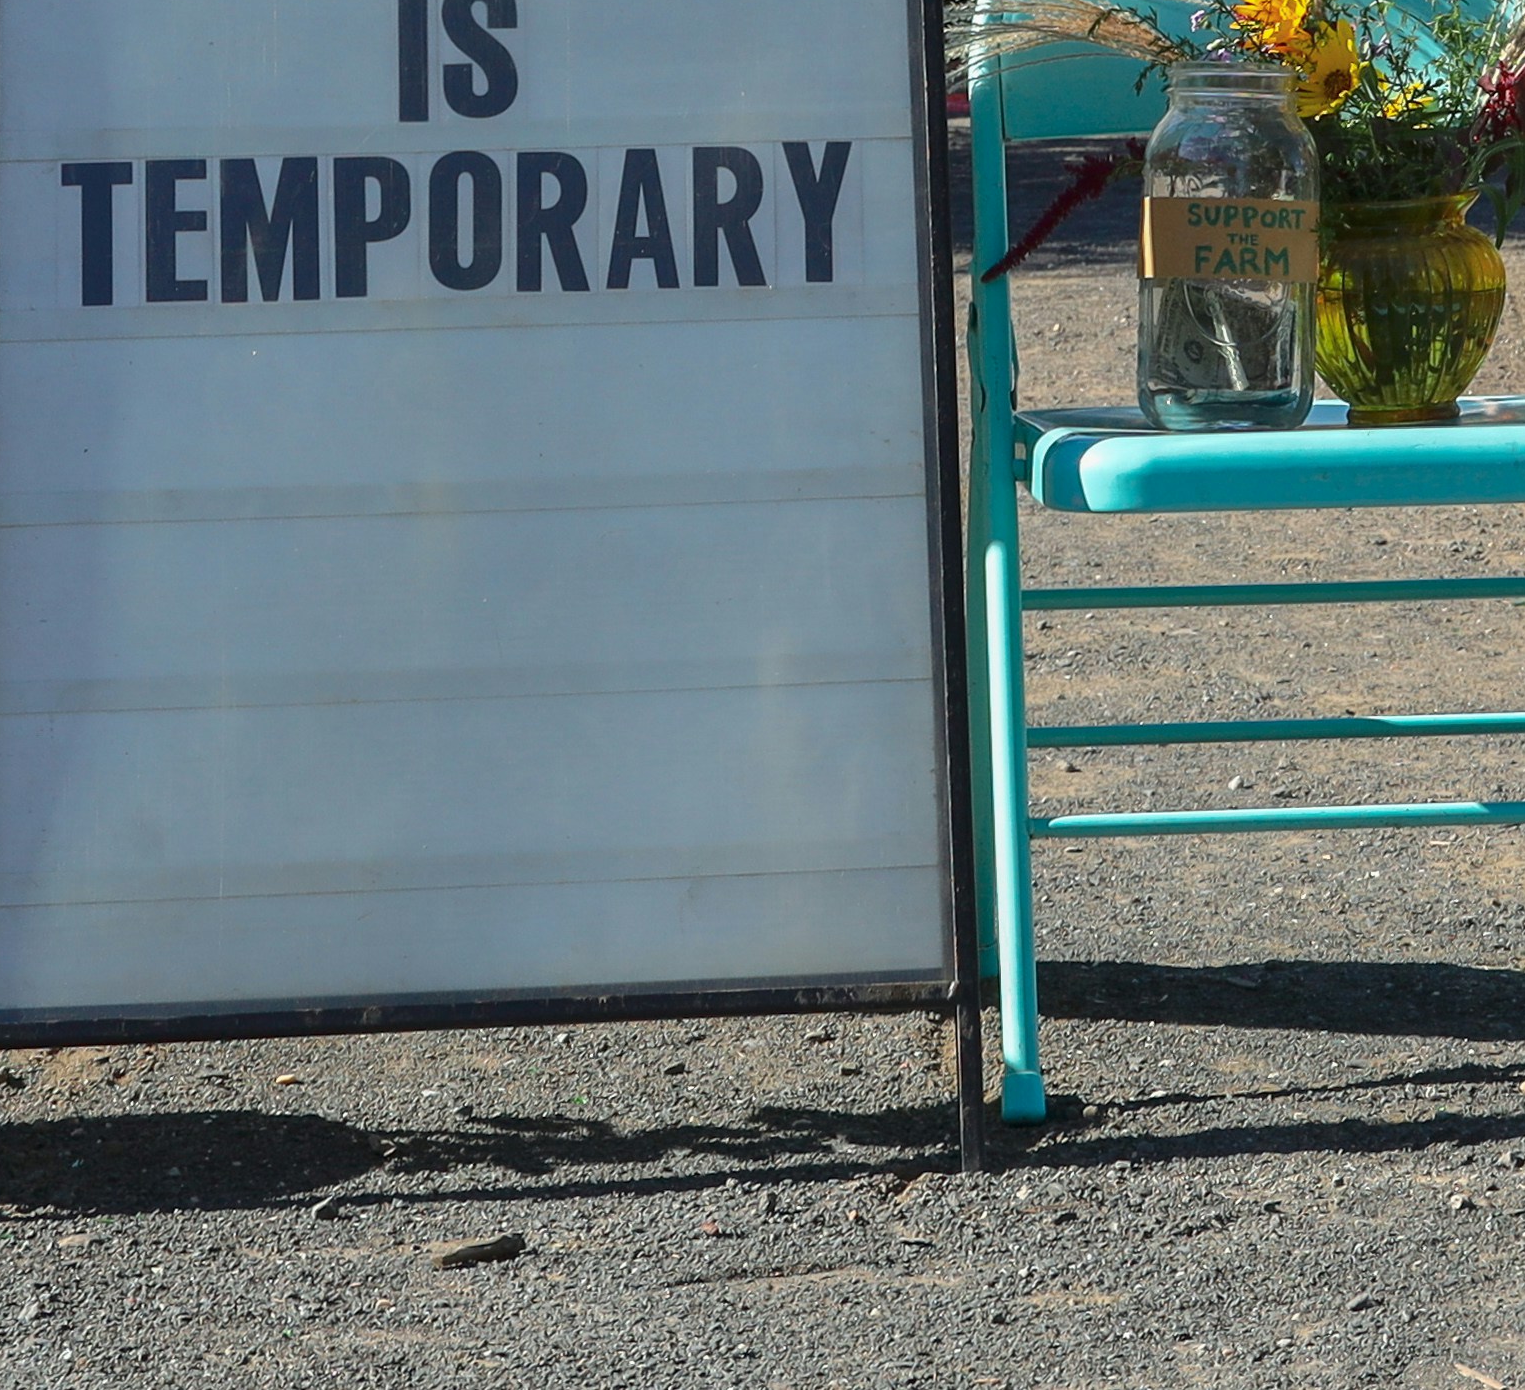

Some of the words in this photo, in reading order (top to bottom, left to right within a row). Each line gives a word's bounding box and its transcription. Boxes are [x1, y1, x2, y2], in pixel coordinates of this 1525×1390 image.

[61, 141, 852, 307] TEMPORARY
[1187, 202, 1306, 230] SUPPORT
[1227, 233, 1260, 246] THE
[1195, 245, 1290, 276] FARM
